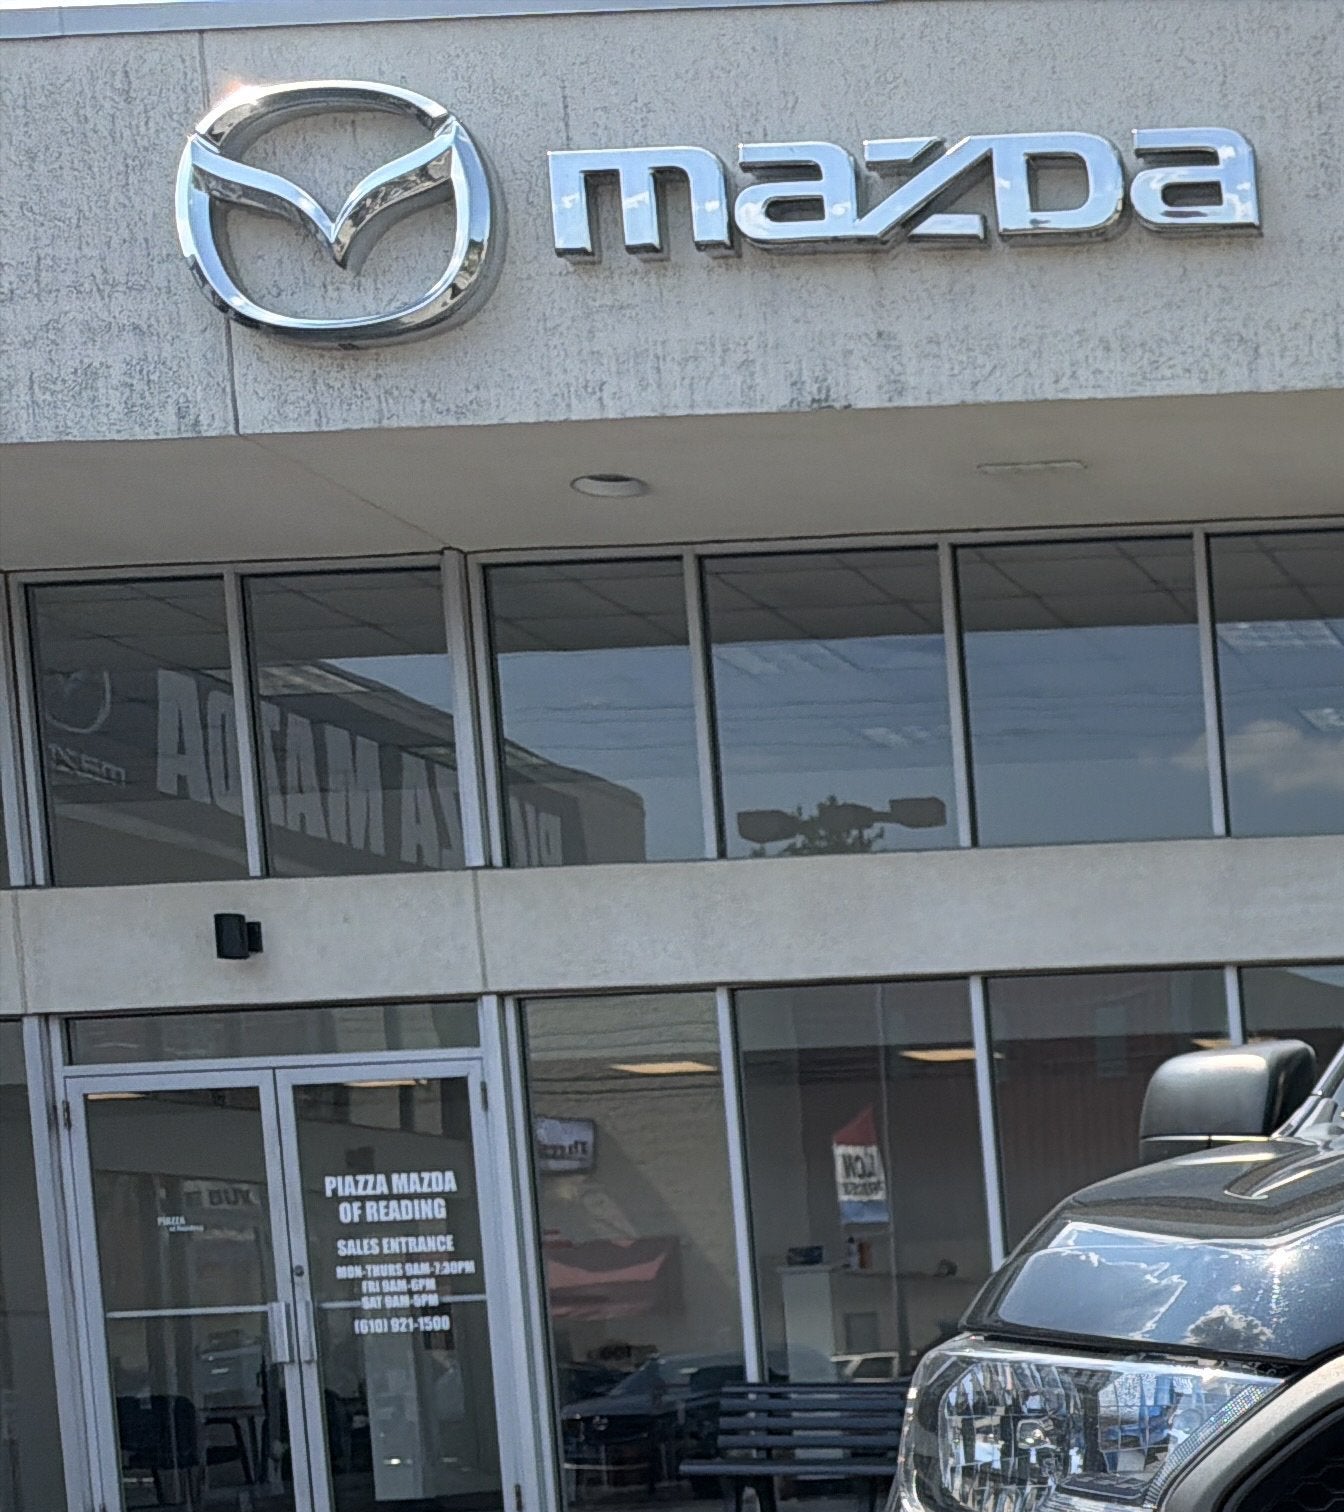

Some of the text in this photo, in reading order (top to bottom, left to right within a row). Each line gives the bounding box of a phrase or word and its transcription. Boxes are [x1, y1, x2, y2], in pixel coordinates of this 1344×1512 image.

[324, 1170, 458, 1198] PIAZZA MAZDA
[339, 1198, 447, 1224] OF READING
[337, 1235, 455, 1256] SALES ENTRANCE
[335, 1263, 403, 1279] MON-THURS
[361, 1280, 380, 1294] FRI
[361, 1295, 382, 1310] SAT
[353, 1315, 451, 1335] (610) 921-1500
